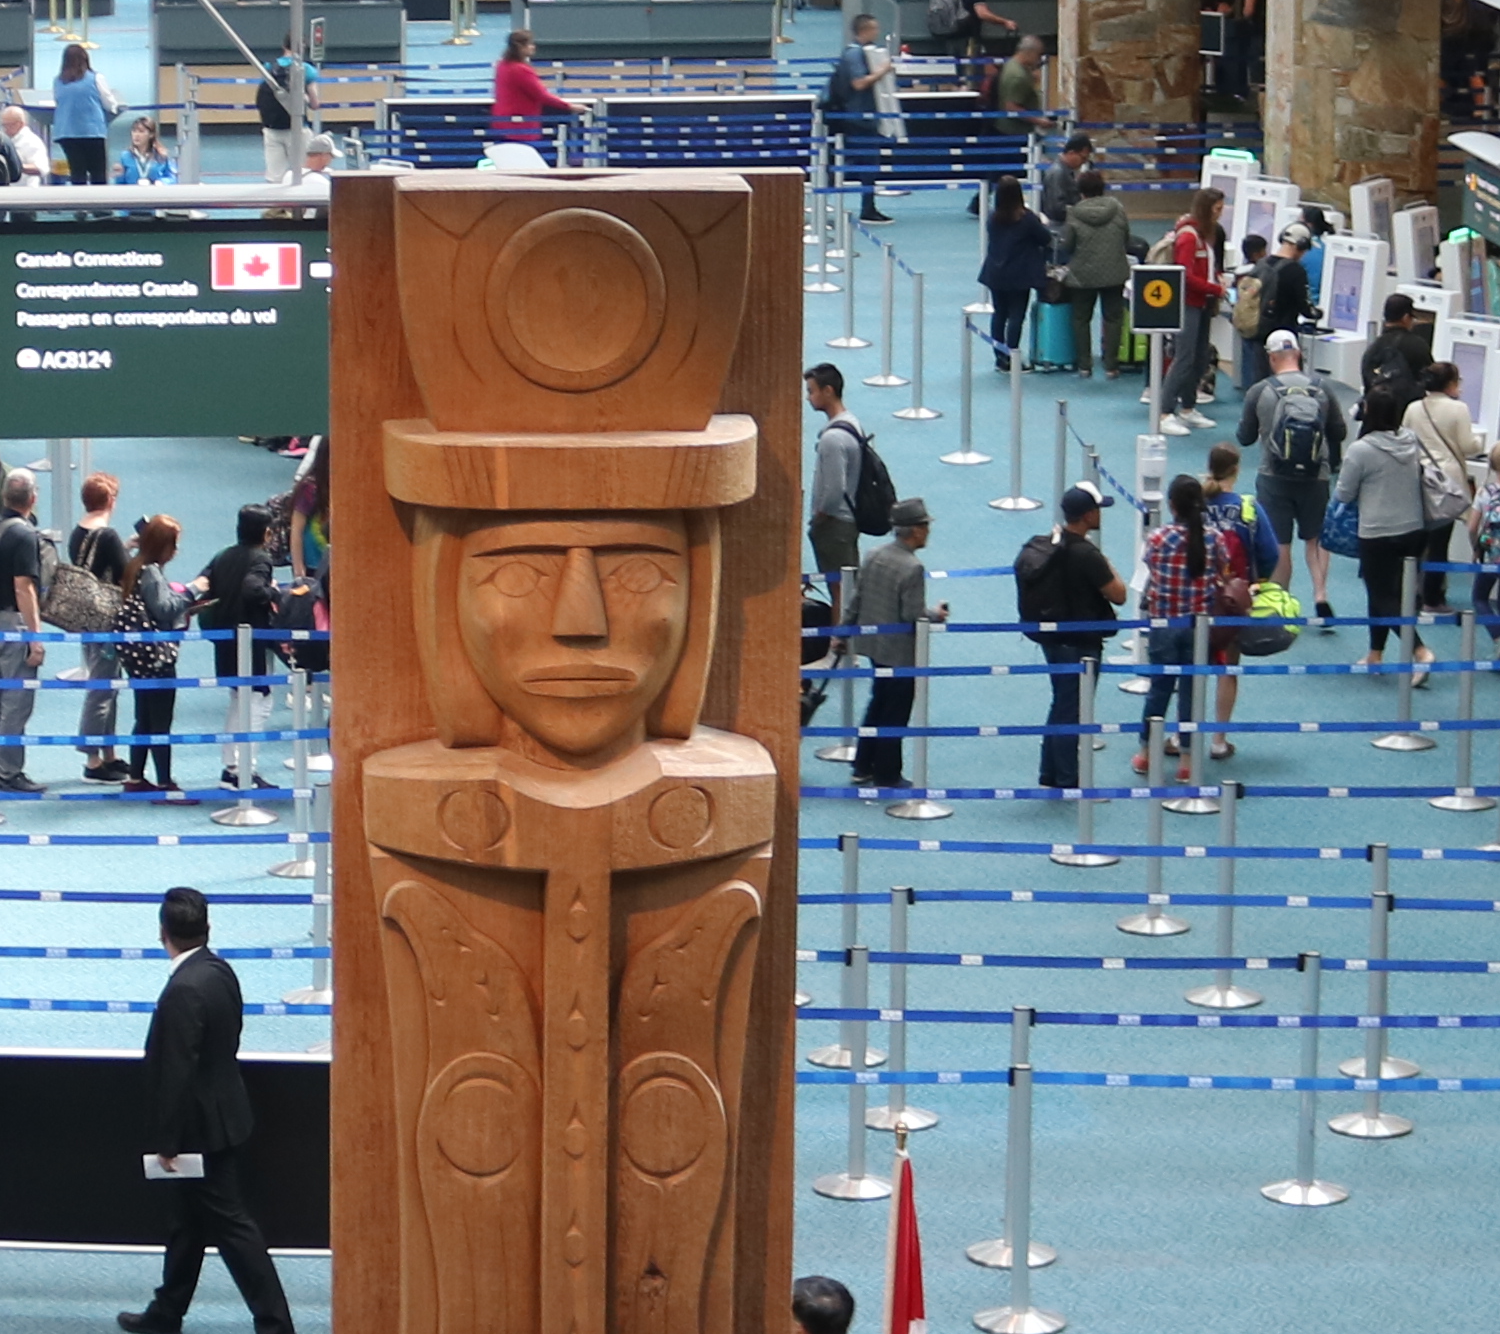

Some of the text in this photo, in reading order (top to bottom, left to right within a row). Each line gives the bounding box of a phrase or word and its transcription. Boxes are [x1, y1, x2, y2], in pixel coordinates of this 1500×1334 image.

[15, 251, 163, 267] Canada Connections
[16, 281, 199, 300] Correspondances Canada
[1151, 285, 1162, 301] 4
[16, 308, 277, 329] Passagers en correspondance du vol
[41, 350, 112, 369] AC8124
